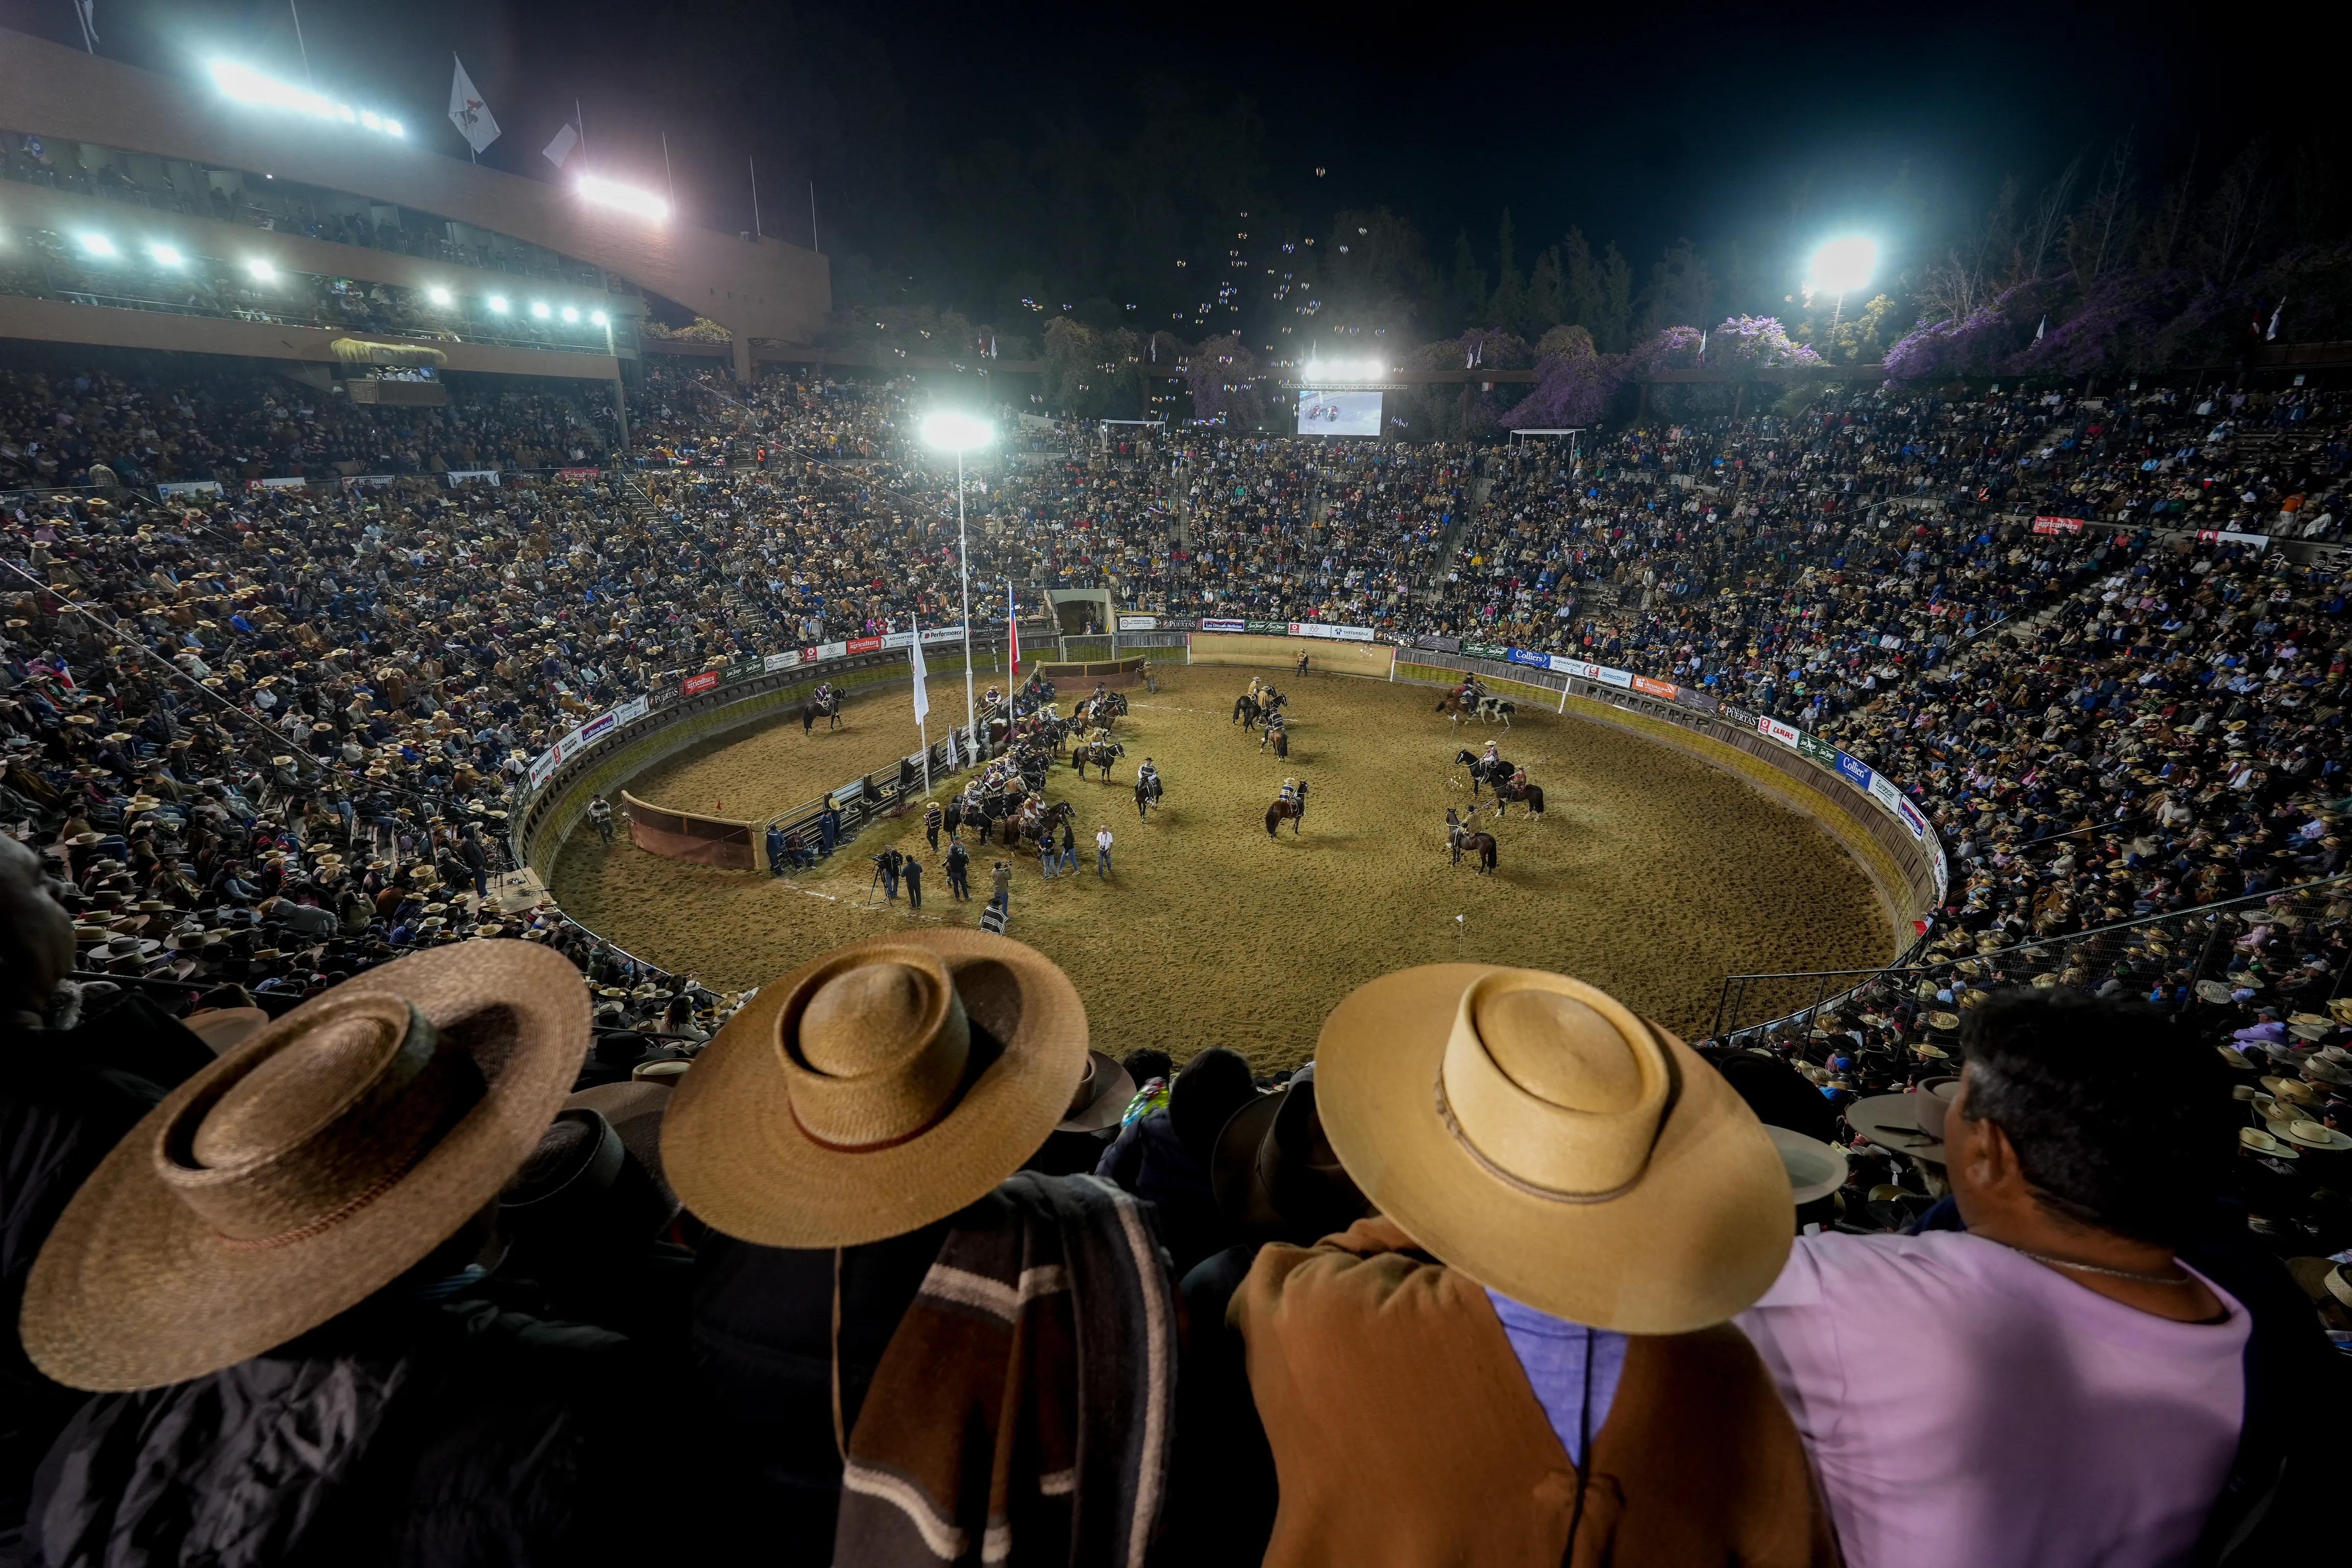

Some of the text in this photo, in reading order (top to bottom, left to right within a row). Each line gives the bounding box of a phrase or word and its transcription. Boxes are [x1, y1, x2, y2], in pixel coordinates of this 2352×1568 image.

[2038, 520, 2078, 530] agricultura
[1384, 633, 1414, 644] PUERTAS
[850, 640, 878, 649] agricultura
[1515, 650, 1542, 662] Colliers
[1554, 659, 1581, 668] ADVANTAGE
[732, 668, 742, 676] Jorge
[687, 676, 715, 689] agricultura
[654, 688, 678, 703] PUERTAS
[1726, 706, 1756, 726] PUERTAS
[1773, 726, 1794, 740] CLAAS
[1825, 750, 1835, 760] Jorge
